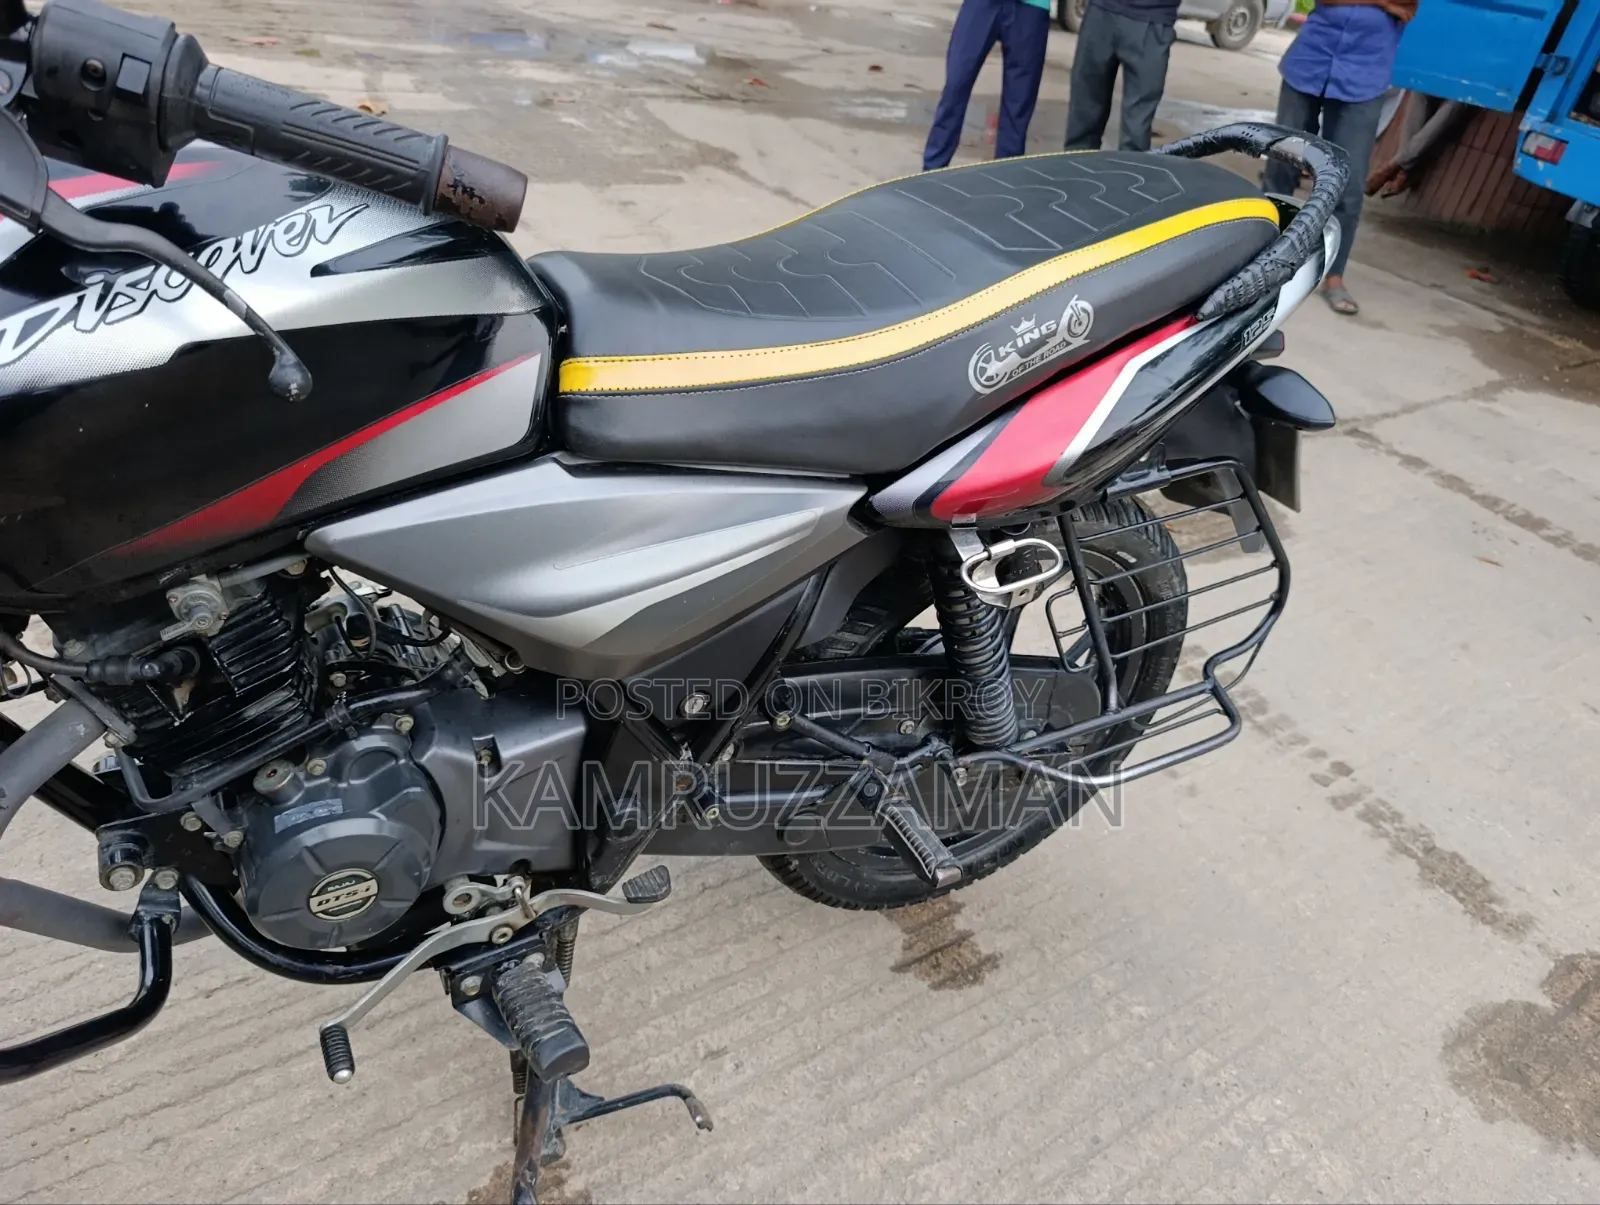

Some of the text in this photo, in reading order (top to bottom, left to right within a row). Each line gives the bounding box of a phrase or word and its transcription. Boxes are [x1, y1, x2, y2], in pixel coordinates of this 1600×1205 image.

[998, 320, 1058, 358] KING
[1243, 306, 1276, 346] 125
[1011, 341, 1067, 377] OF THE ROAD
[327, 880, 355, 891] BAJAJ
